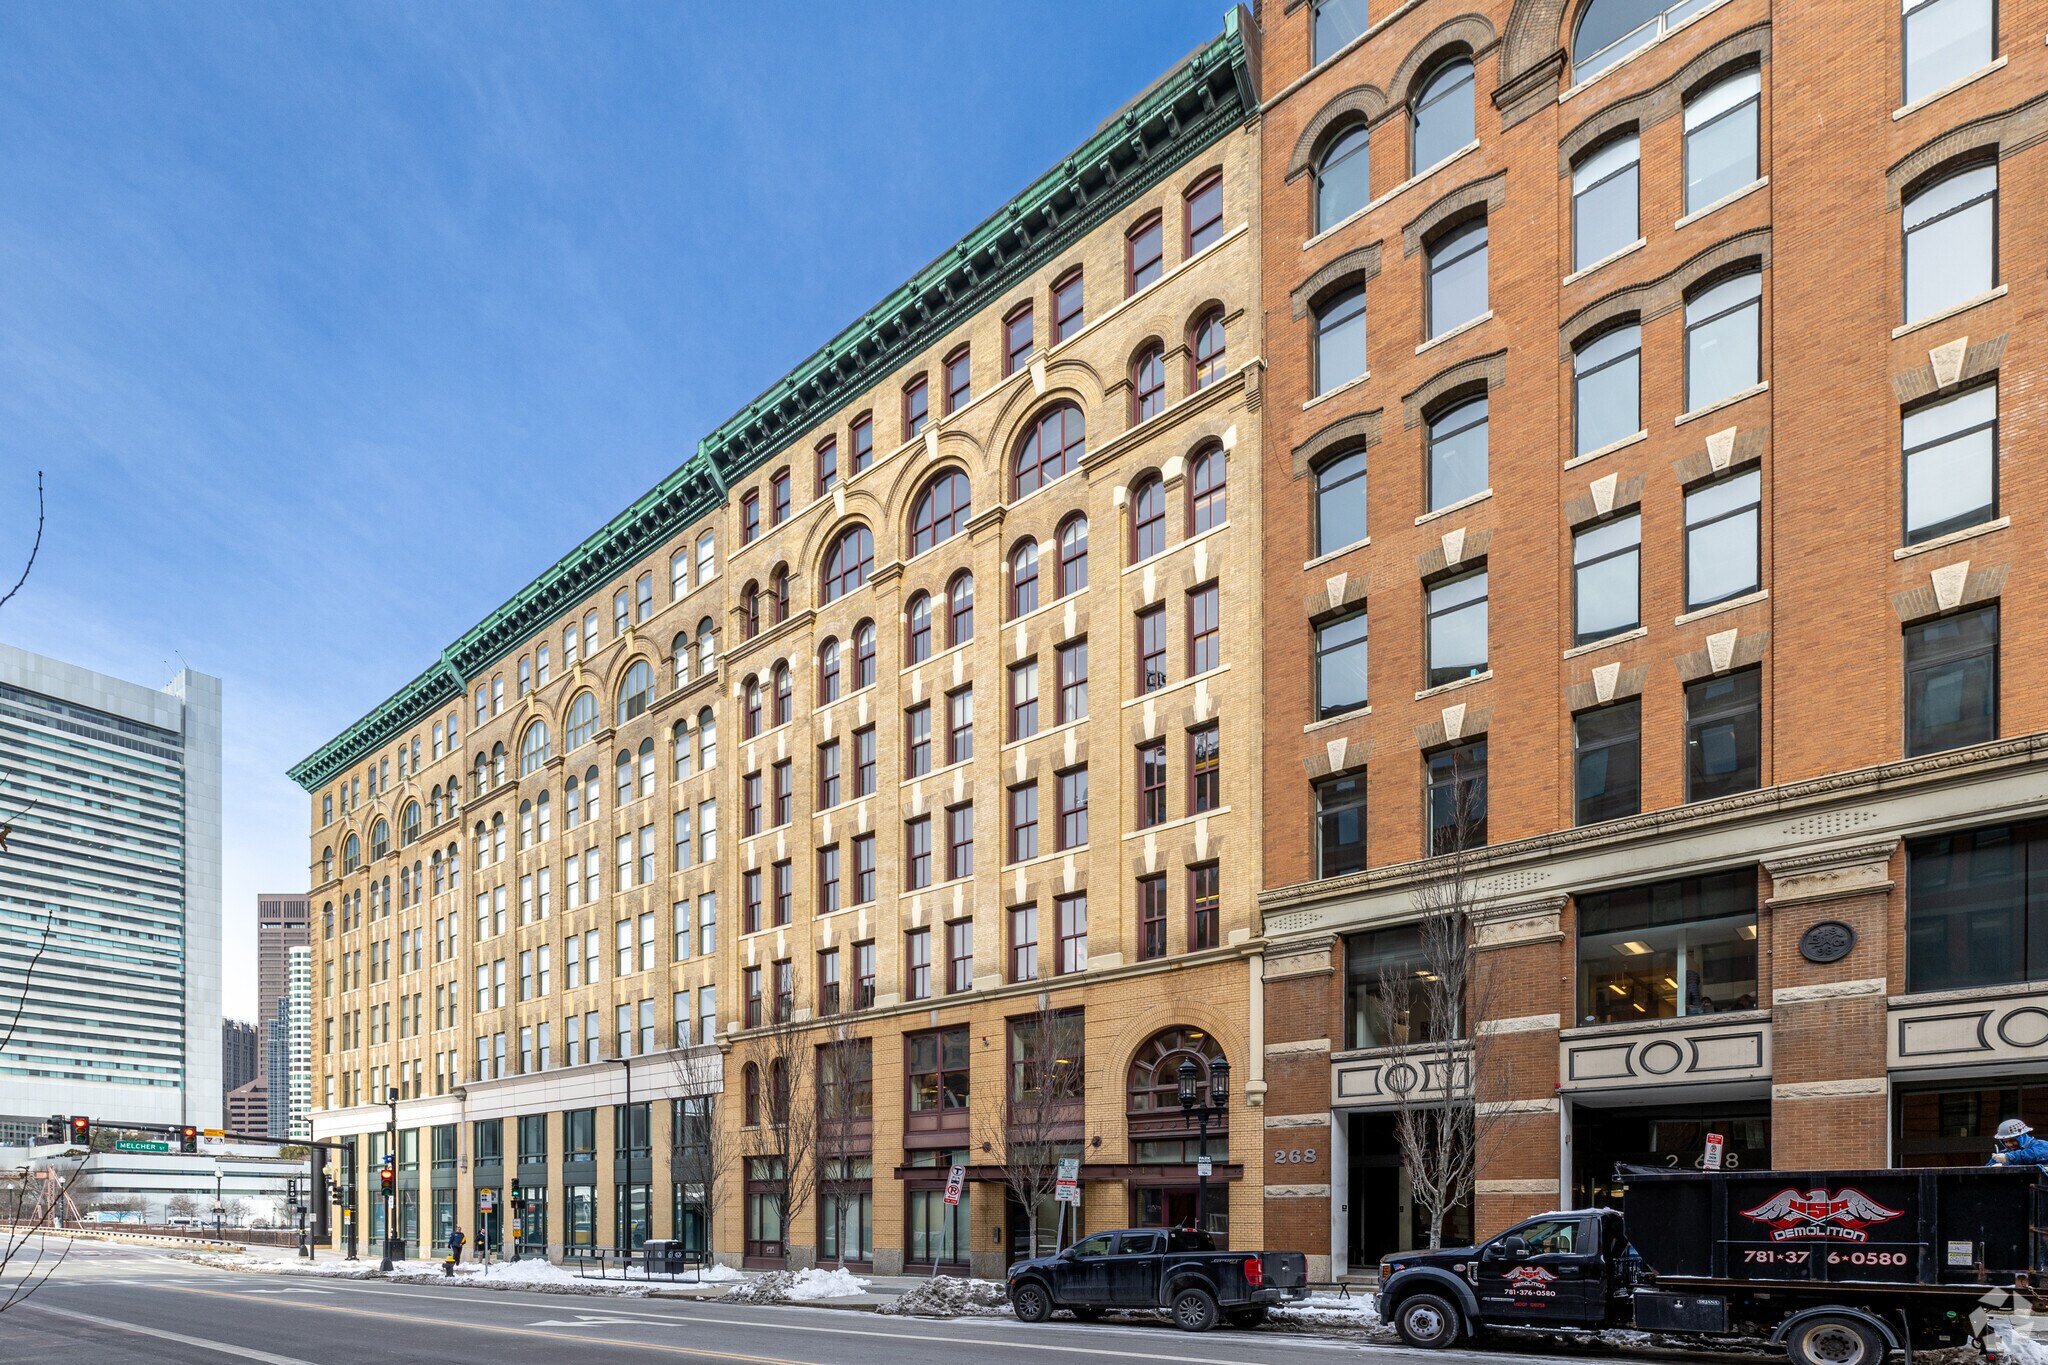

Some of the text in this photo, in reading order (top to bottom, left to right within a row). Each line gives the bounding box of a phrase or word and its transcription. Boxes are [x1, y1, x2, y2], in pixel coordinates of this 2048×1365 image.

[120, 1142, 156, 1150] MELCHER
[1274, 1149, 1317, 1164] 268
[1789, 1199, 1849, 1220] USA
[1773, 1226, 1866, 1241] DEMOLITION
